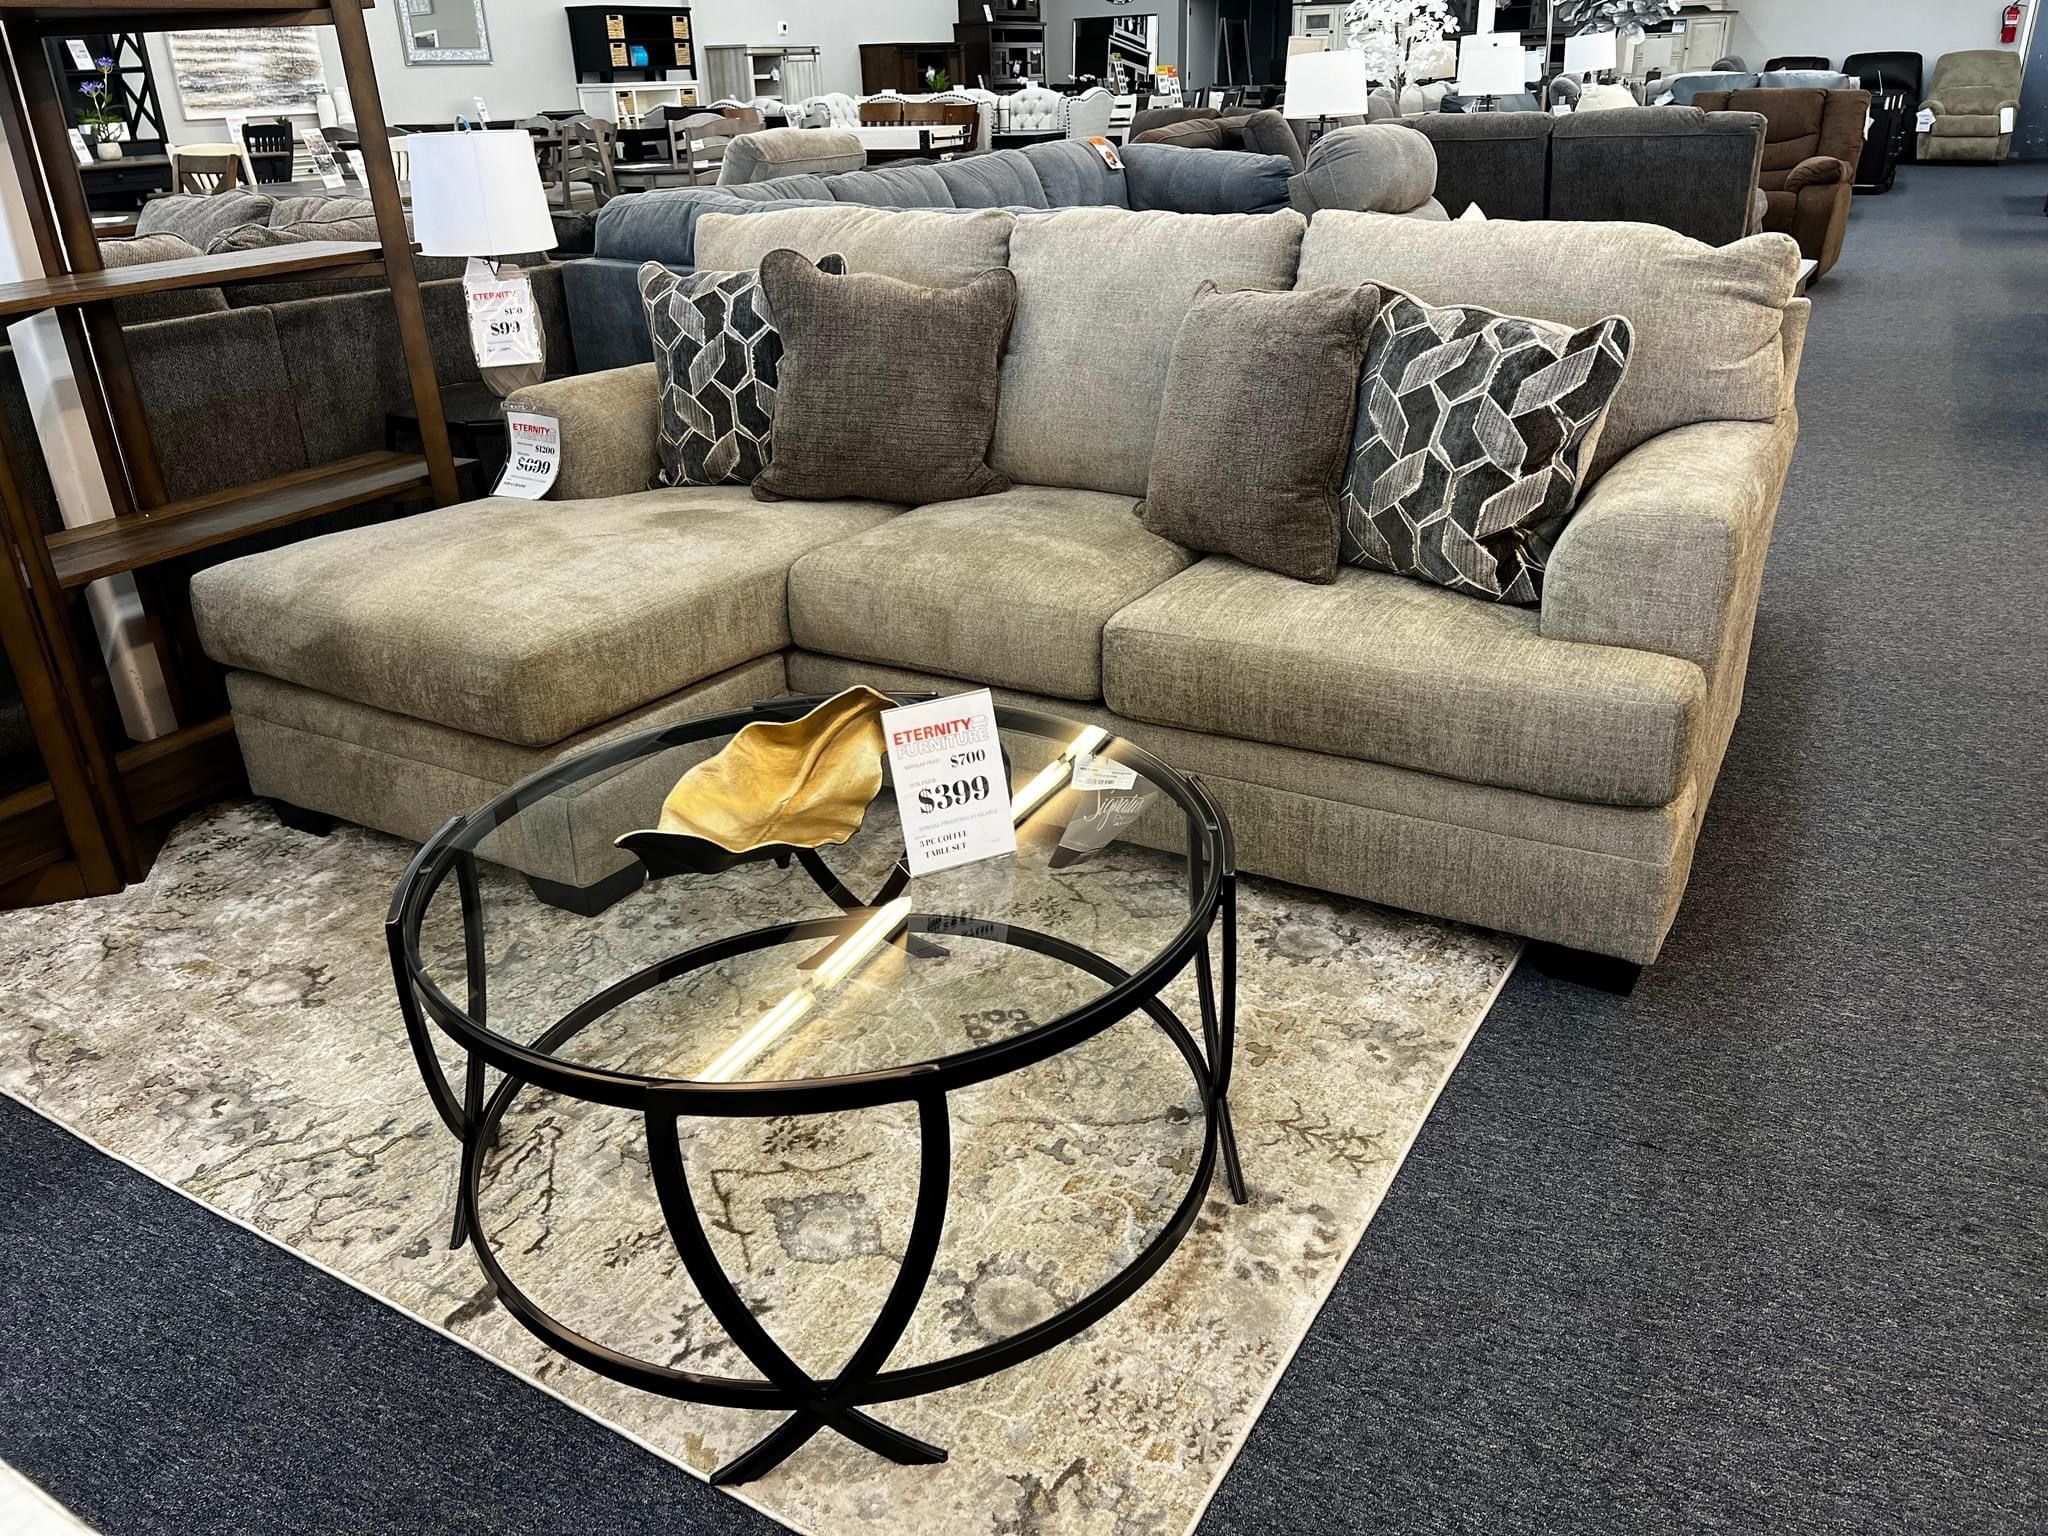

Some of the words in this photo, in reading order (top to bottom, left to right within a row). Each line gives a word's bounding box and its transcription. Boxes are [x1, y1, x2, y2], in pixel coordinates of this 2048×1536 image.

[504, 307, 523, 315] $10
[490, 321, 520, 336] $99
[512, 423, 550, 435] ETERNITY
[535, 445, 555, 455] $1200
[516, 457, 551, 475] $699
[893, 717, 971, 746] ETERNITY
[896, 725, 990, 760] FURNITURE
[950, 749, 985, 768] $700
[918, 775, 990, 815] $399
[937, 830, 968, 844] COFFEE
[925, 846, 949, 858] TABLE
[951, 842, 967, 852] SET
